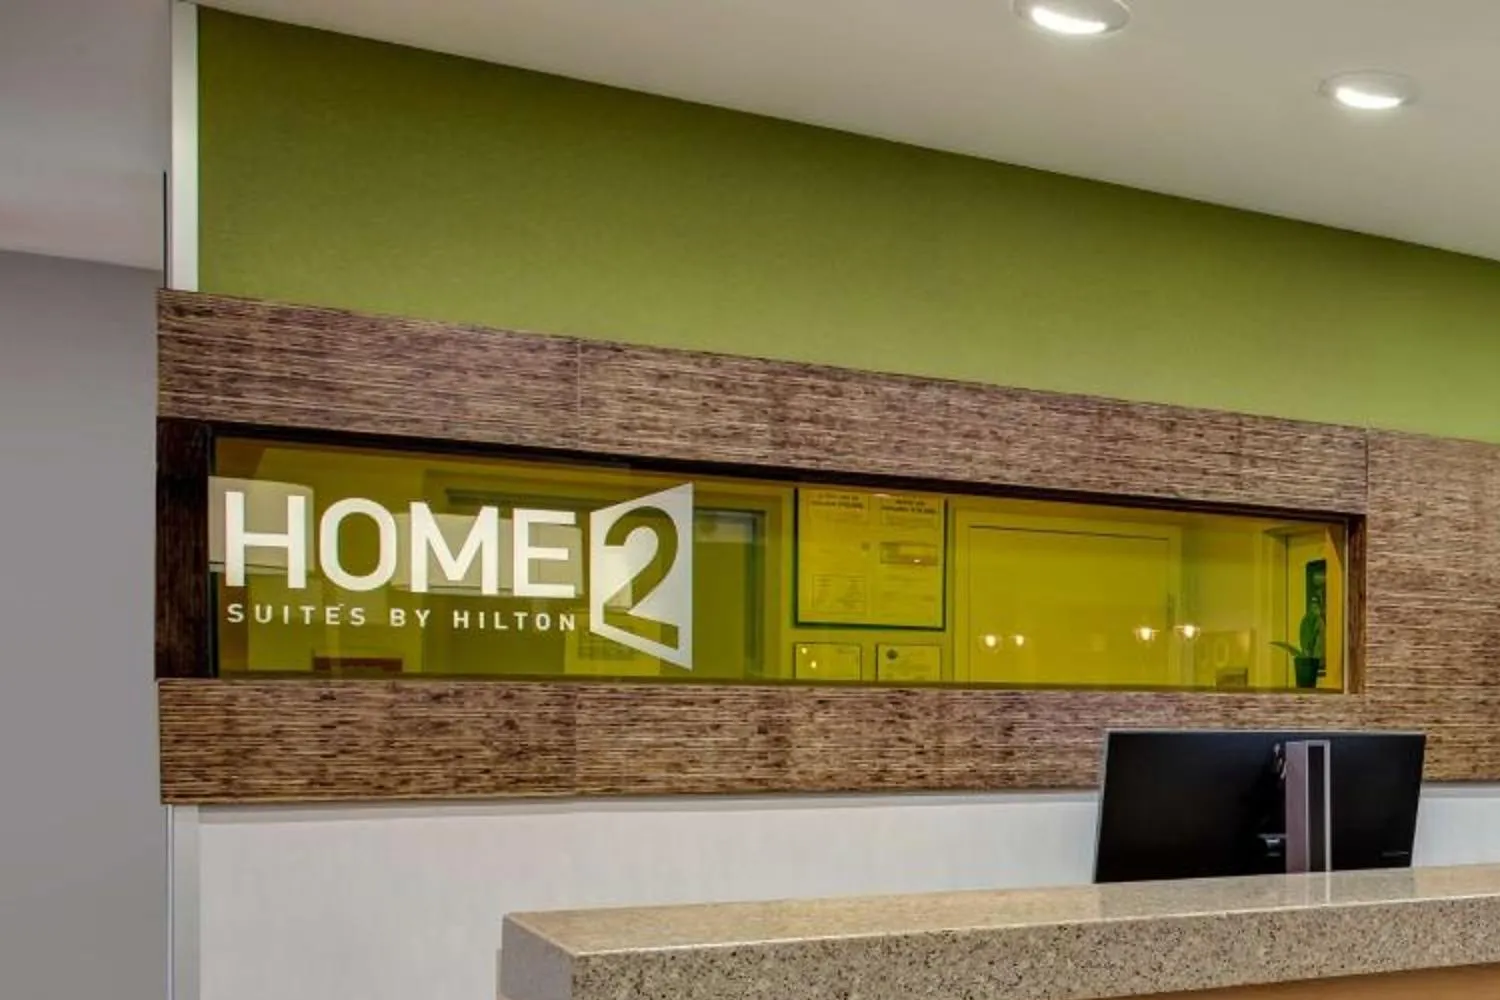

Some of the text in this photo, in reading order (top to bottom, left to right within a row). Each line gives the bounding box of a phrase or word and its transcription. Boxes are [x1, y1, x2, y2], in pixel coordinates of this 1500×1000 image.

[226, 603, 576, 632] SUITES BY HILTON
